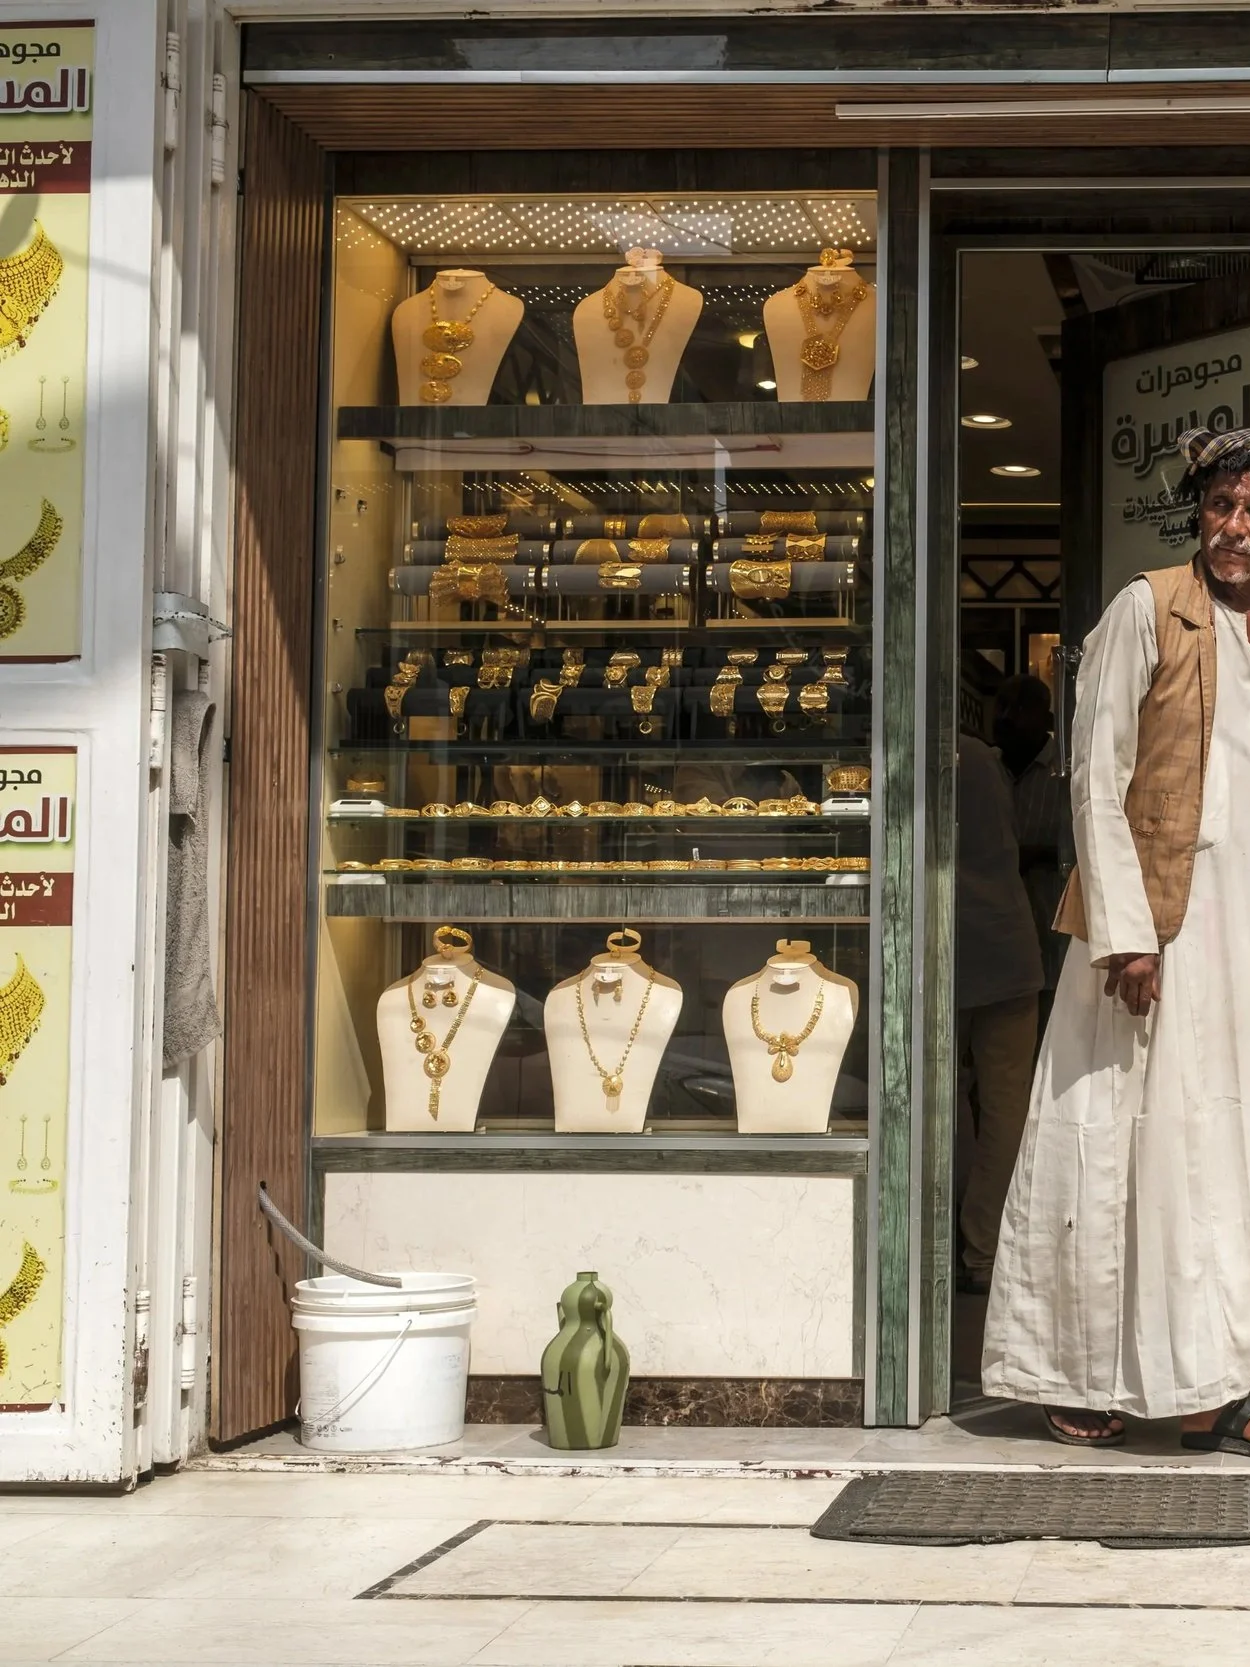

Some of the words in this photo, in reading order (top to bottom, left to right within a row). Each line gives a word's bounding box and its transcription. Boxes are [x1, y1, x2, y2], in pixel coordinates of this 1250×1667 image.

[0, 42, 61, 64] مجوه
[19, 144, 74, 165] لأحدث
[1136, 354, 1242, 397] مجوهرات
[0, 874, 55, 897] لأحدث
